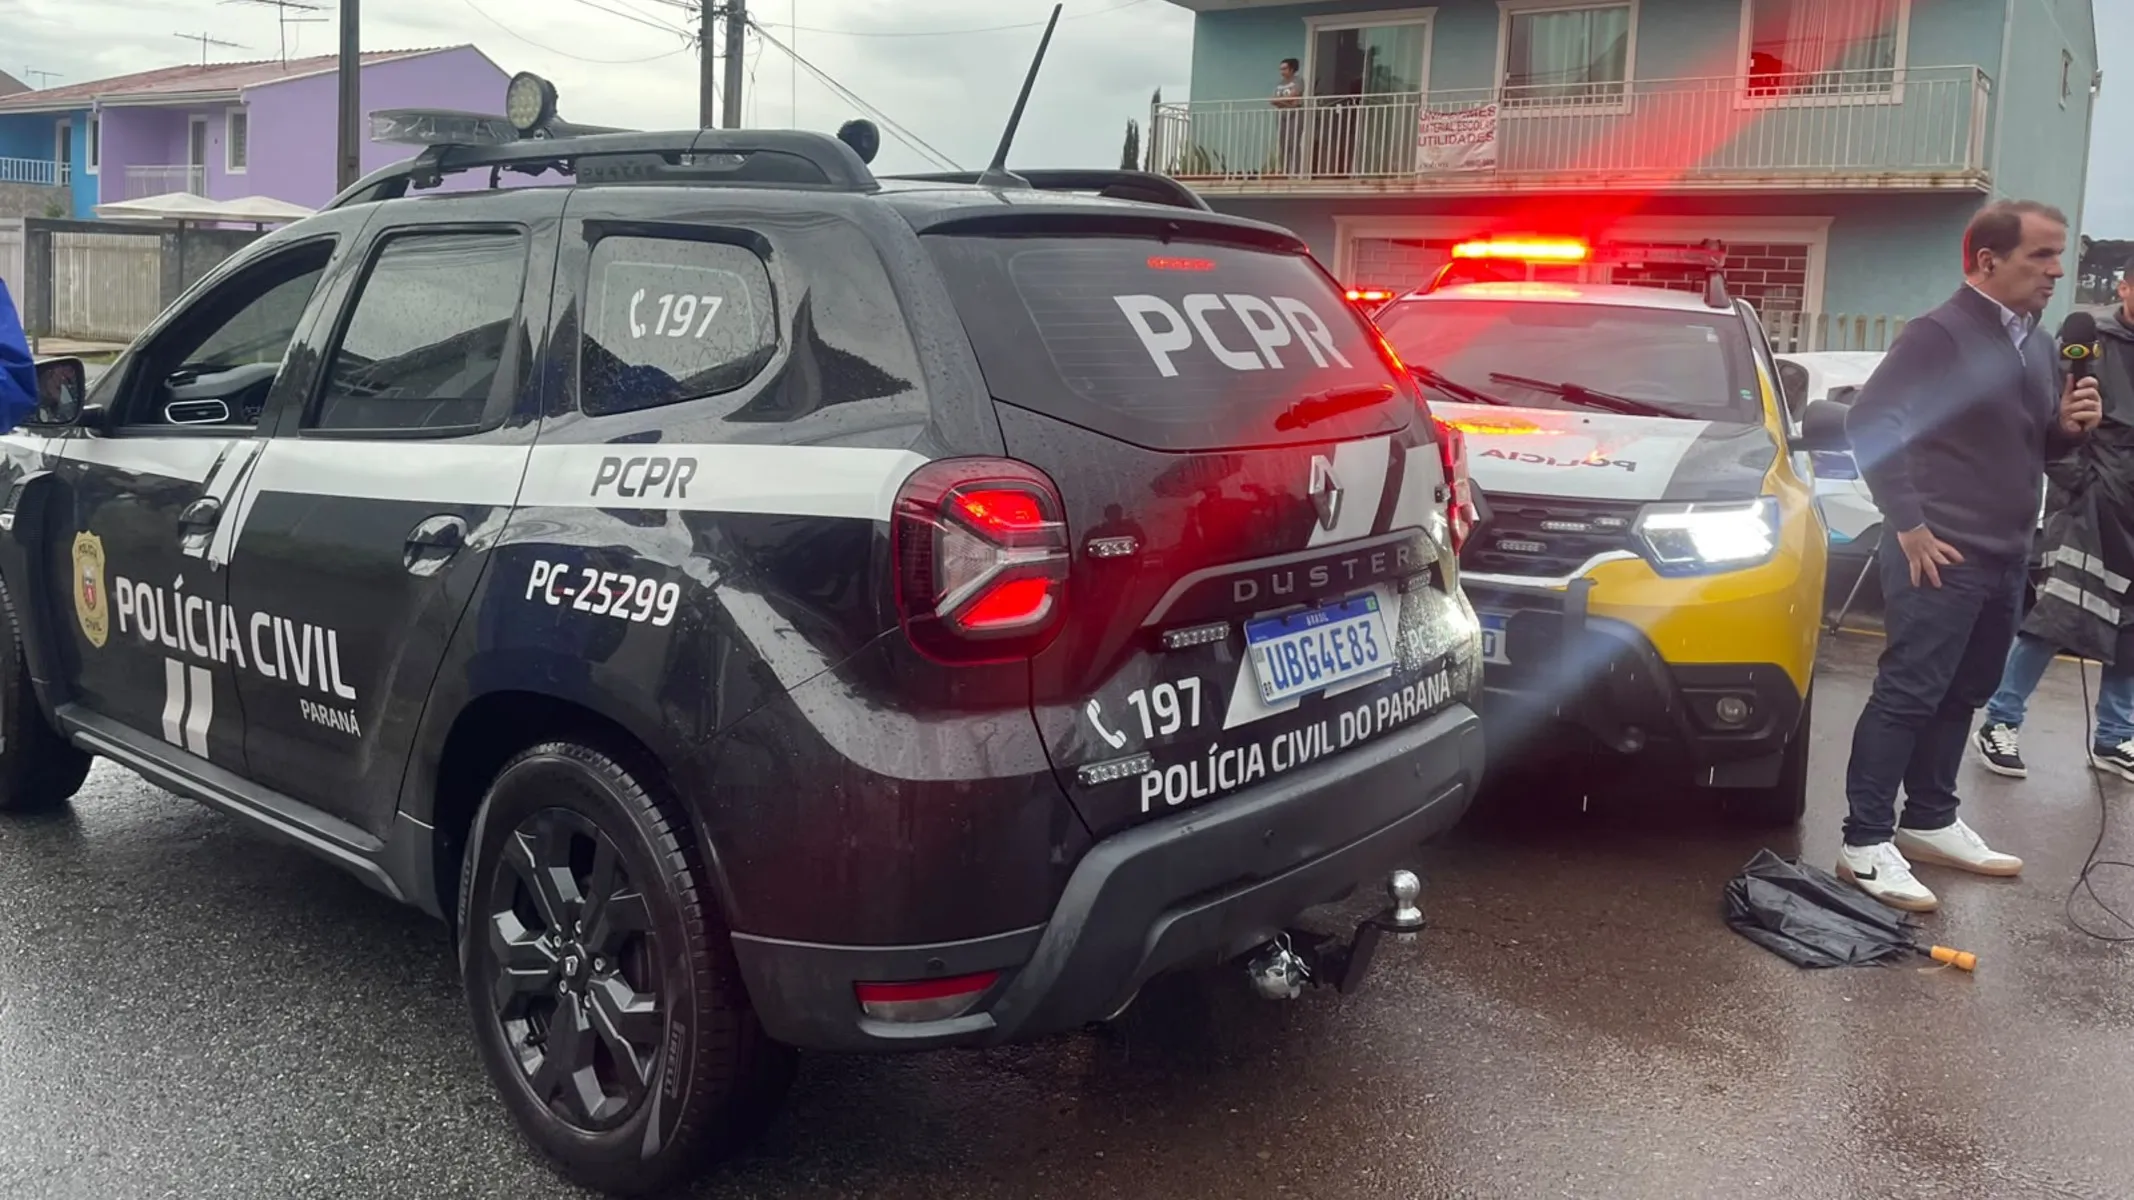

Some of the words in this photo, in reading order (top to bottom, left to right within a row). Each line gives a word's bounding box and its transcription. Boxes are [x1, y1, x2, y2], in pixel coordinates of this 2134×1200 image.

[1418, 132, 1494, 147] UTILIDADES
[655, 294, 722, 339] 197
[1113, 293, 1353, 377] PCPR
[590, 456, 698, 499] PCPR
[525, 560, 680, 627] PC-25299
[1233, 544, 1411, 603] DUSTER
[115, 574, 246, 669] POLÍCIA
[250, 611, 357, 700] CIVIL
[1266, 620, 1379, 690] UBG4E83
[299, 697, 361, 738] PARANÁ
[1127, 676, 1202, 739] 197
[1140, 742, 1266, 812] POLÍCIA
[1271, 721, 1335, 771] CIVIL
[1339, 708, 1372, 747] DO
[1377, 658, 1451, 733] PARANÁ
